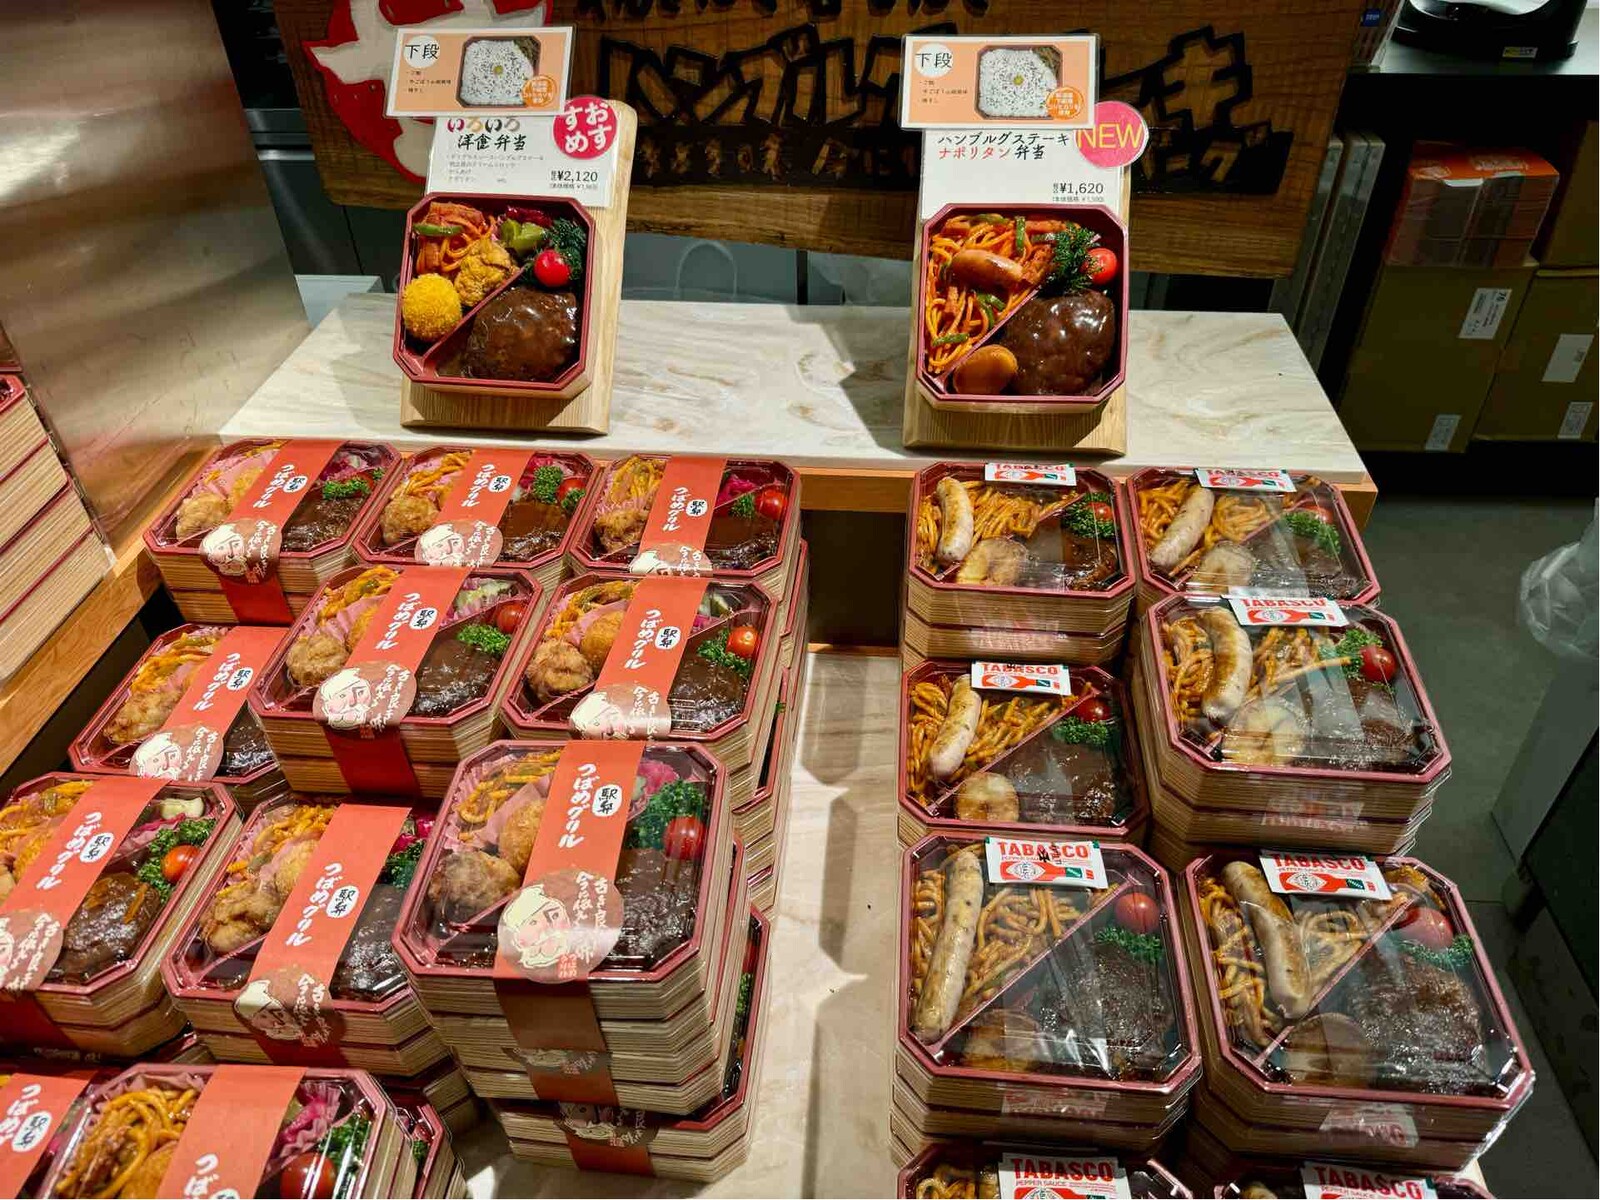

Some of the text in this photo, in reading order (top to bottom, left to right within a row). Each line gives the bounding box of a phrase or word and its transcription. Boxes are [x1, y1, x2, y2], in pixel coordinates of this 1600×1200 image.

[405, 43, 440, 60] 下段
[915, 52, 952, 68] 下段
[938, 132, 1070, 146] ハンブルグステーキ
[1077, 124, 1143, 150] NEW
[938, 145, 1045, 160] ナポリタン 弁当
[557, 171, 598, 184] ¥2,120
[1060, 183, 1104, 196] ¥1,620
[253, 464, 295, 508] つばめグリル
[461, 464, 496, 507] つばめグリル
[662, 487, 691, 532] つばめグリル
[375, 593, 421, 650] つばめグリル
[624, 609, 664, 669] つばめグリル
[193, 652, 242, 712] つばめグリル
[558, 763, 600, 848] つばめグリル
[36, 811, 103, 890] つばめグリル
[997, 841, 1089, 859] TABASCO
[1272, 853, 1366, 871] TABASCO
[285, 862, 344, 947] つばめグリル
[1011, 1158, 1114, 1182] TABASCO
[1313, 1166, 1422, 1199] TABASCO
